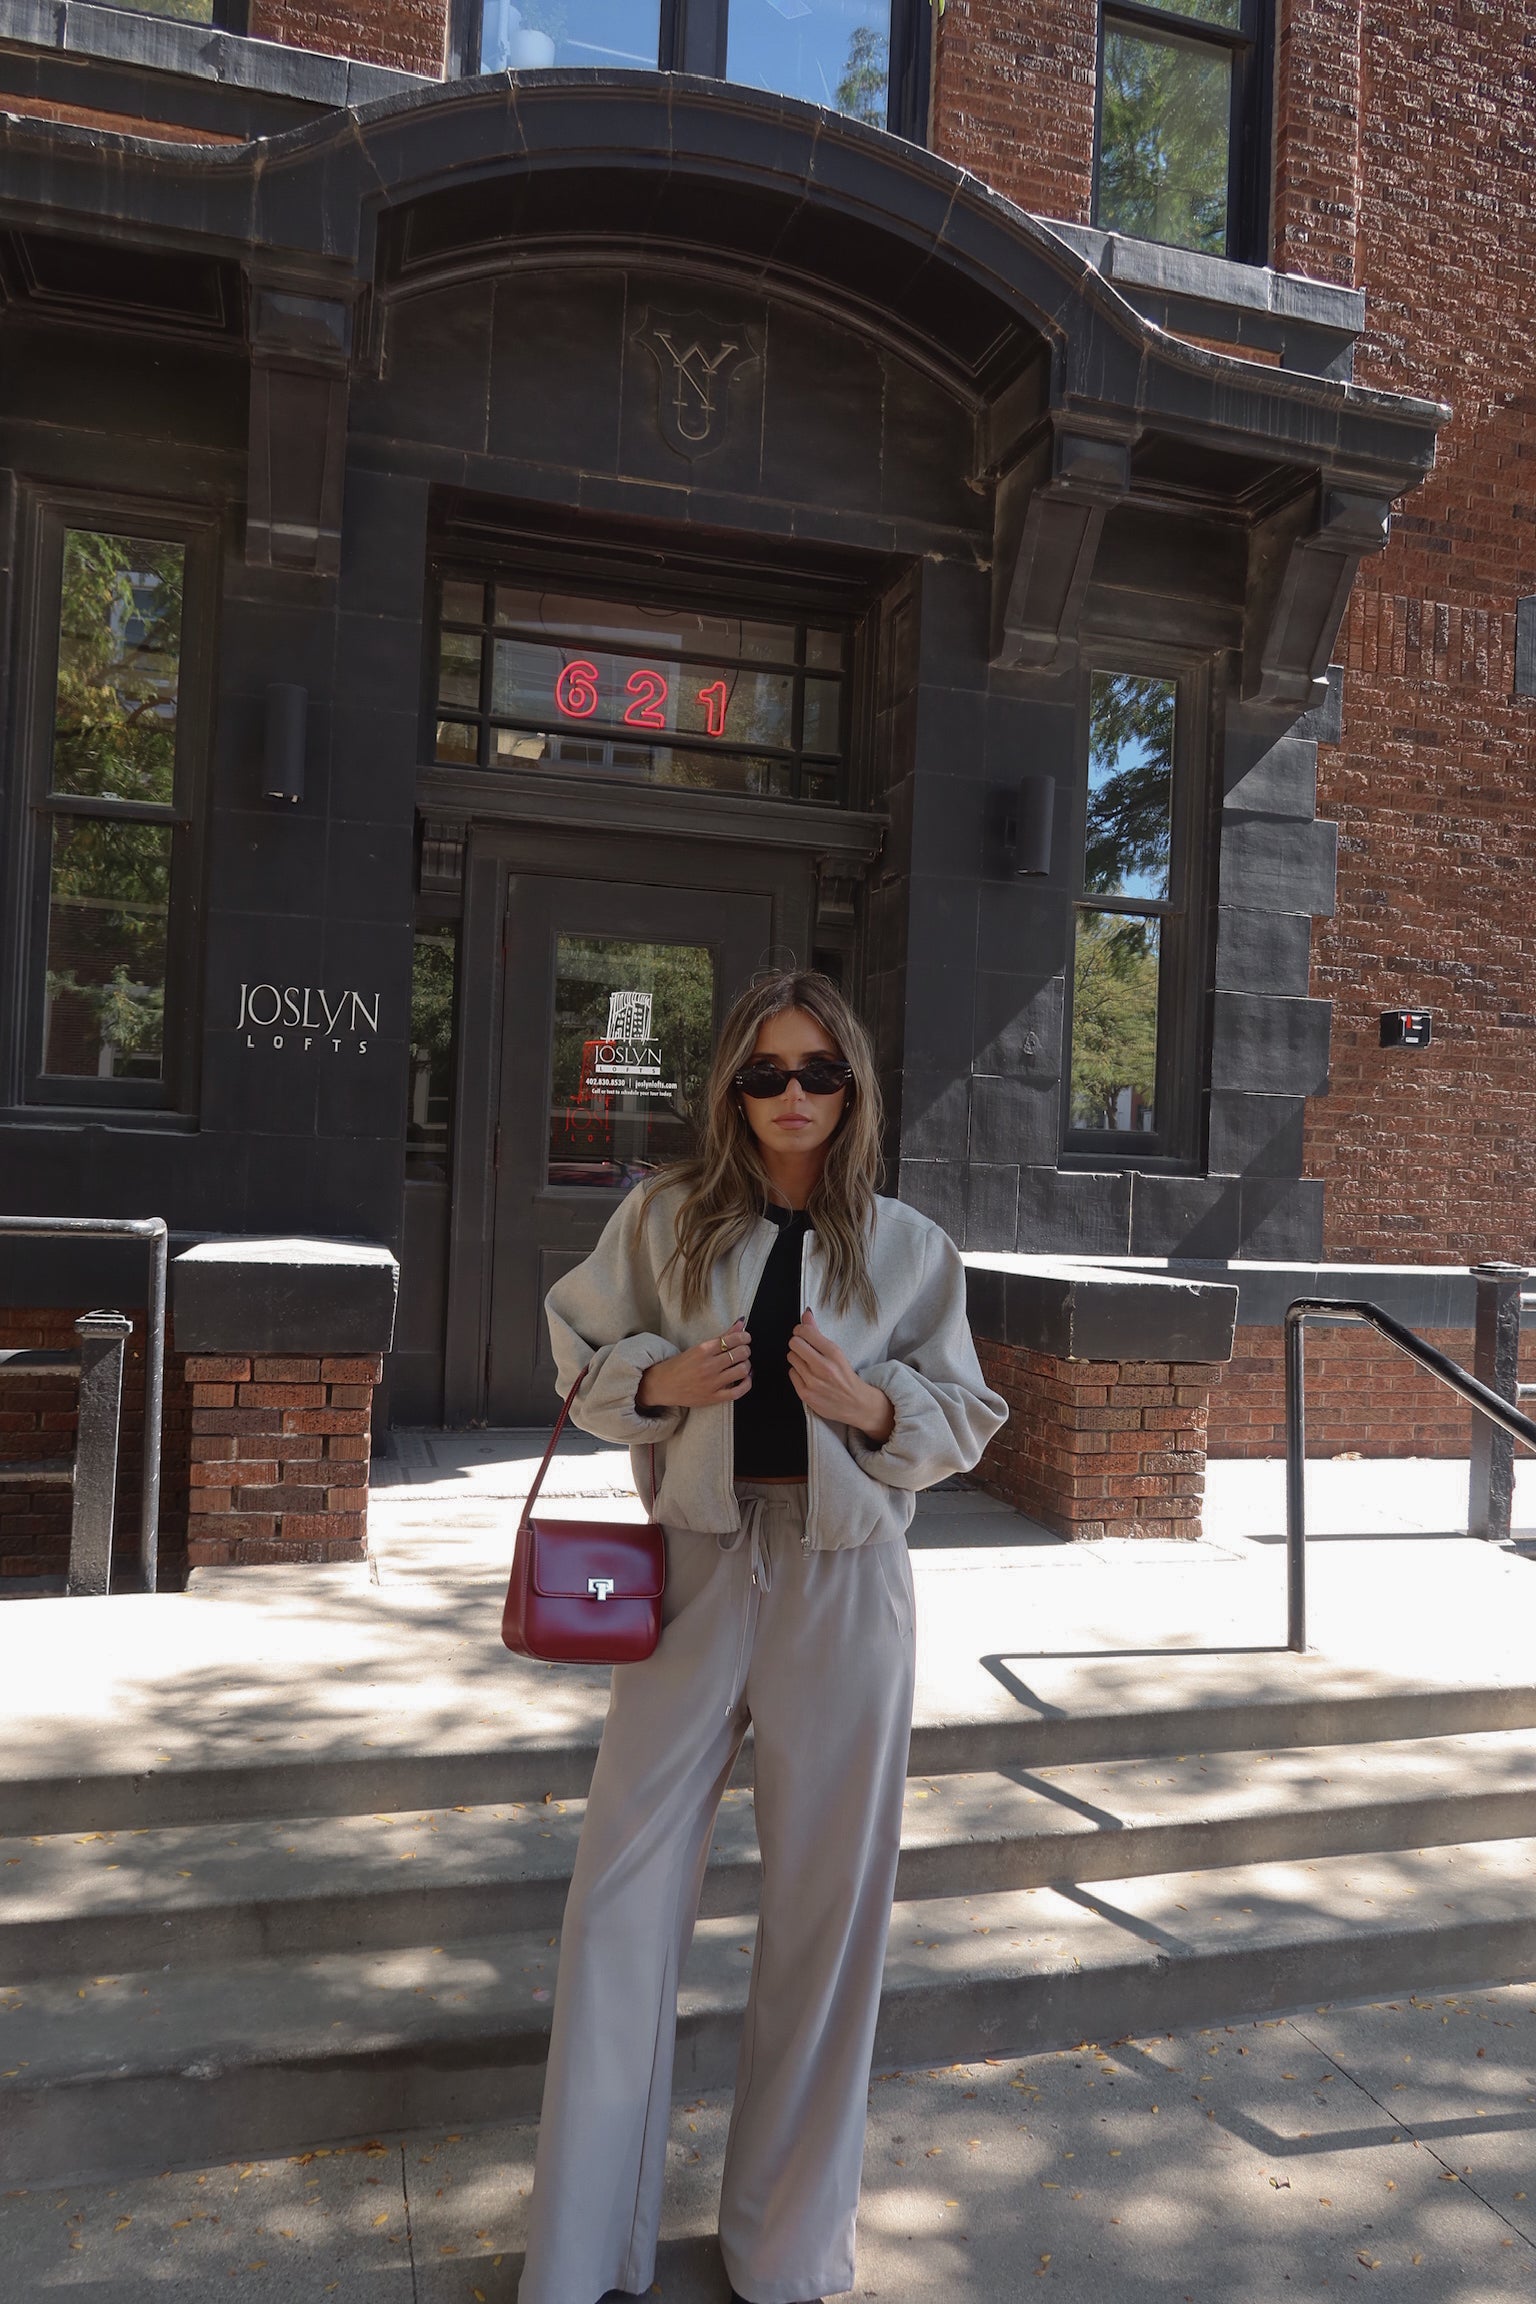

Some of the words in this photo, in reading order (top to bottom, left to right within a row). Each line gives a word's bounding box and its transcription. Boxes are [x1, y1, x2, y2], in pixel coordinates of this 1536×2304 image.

[555, 659, 728, 737] 621
[236, 983, 381, 1036] JOSLYN
[247, 1034, 368, 1054] LOFTS
[594, 1045, 662, 1066] JOSLYN
[599, 1066, 656, 1075] LOFTS
[635, 1079, 678, 1090] joslynlofts.com
